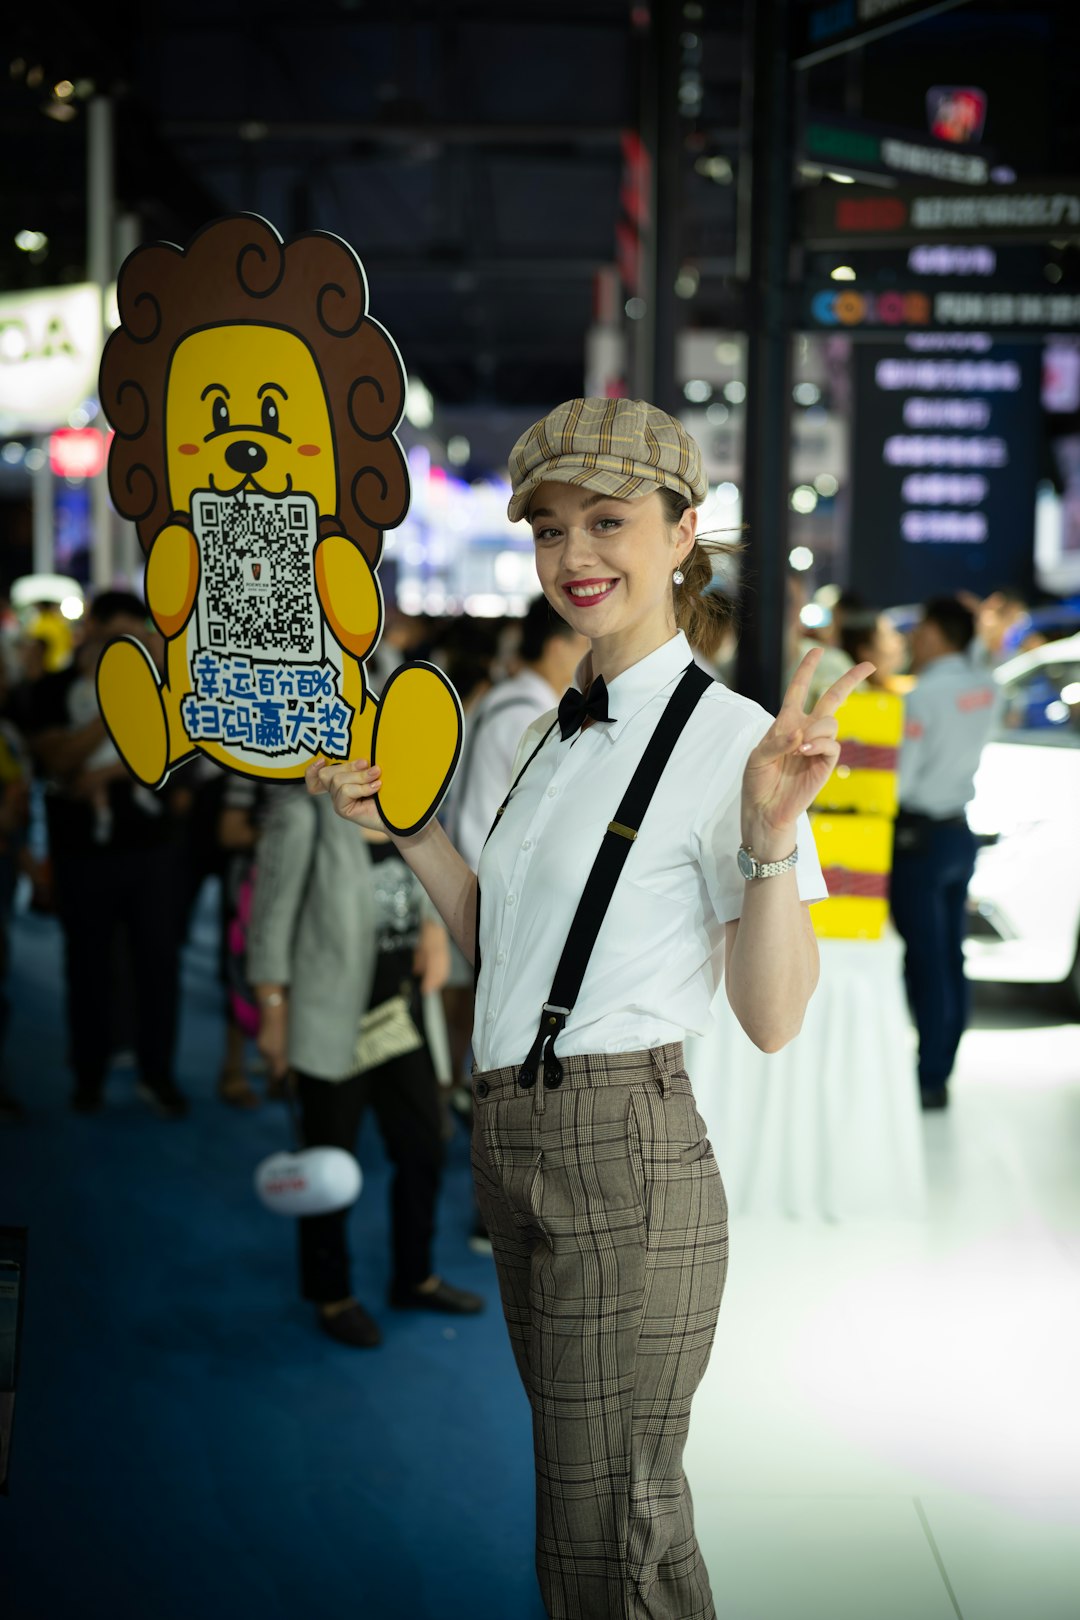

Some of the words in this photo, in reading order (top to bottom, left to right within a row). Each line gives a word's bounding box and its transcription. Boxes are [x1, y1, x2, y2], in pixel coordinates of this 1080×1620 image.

[811, 290, 929, 325] COLOR
[185, 699, 348, 751] 扫码赢大奖
